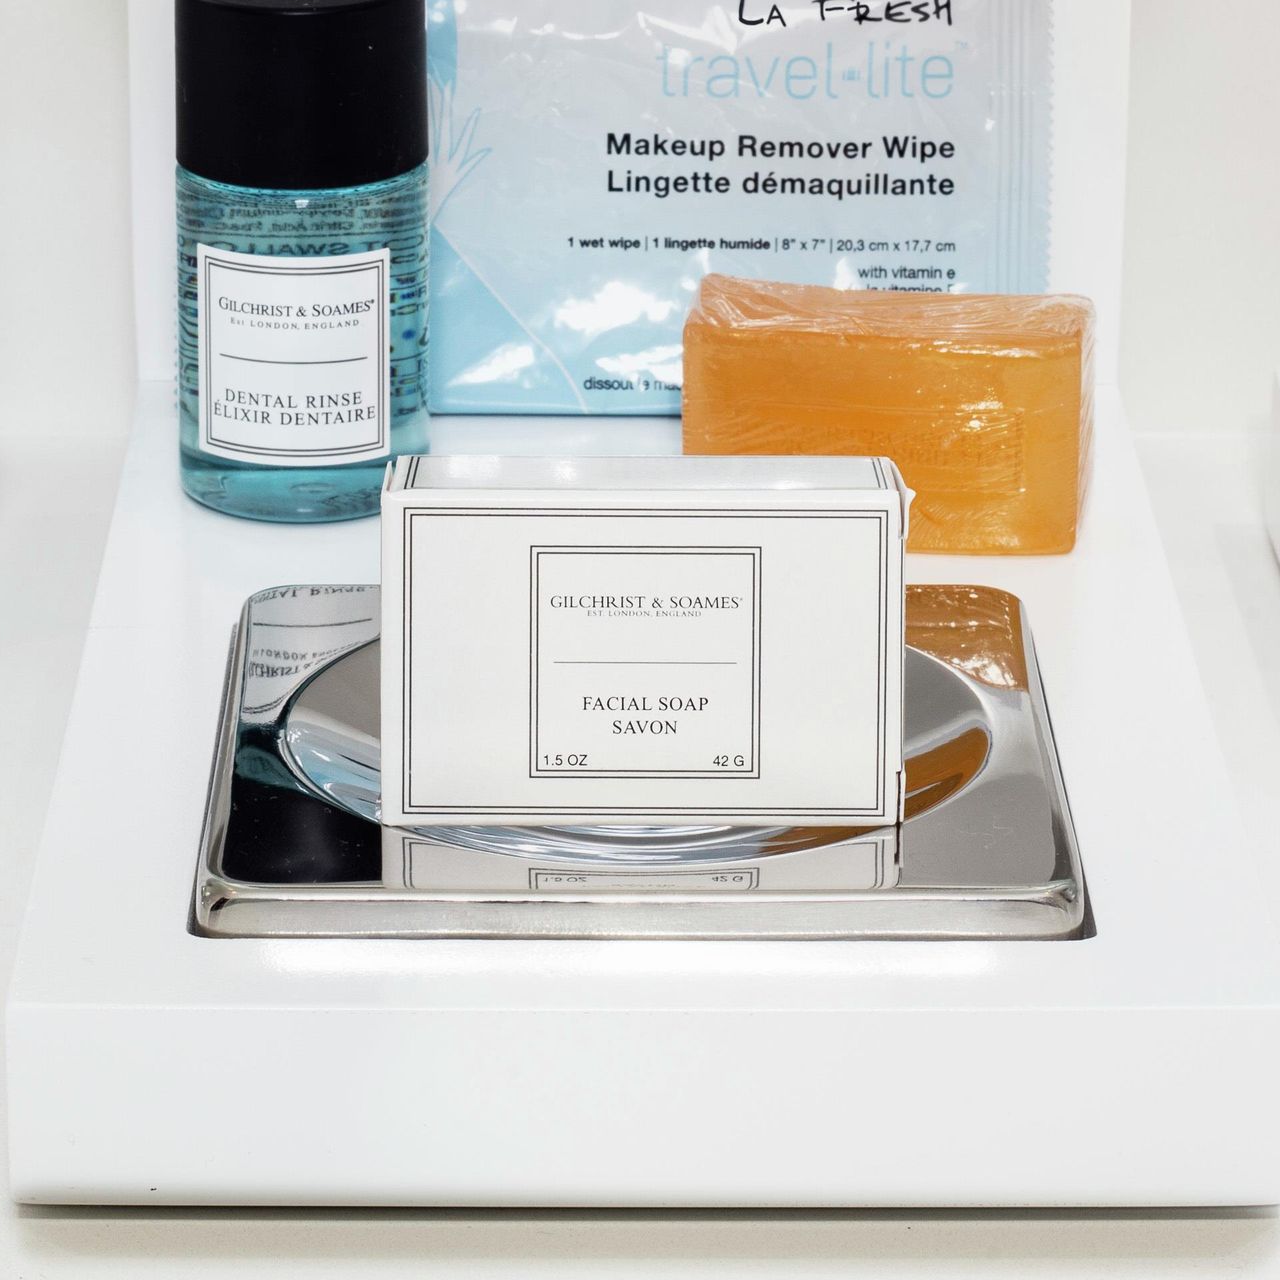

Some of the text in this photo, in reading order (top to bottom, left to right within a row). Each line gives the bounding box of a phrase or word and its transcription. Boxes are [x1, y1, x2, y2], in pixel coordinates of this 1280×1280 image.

[606, 132, 955, 164] Makeup Remover Wipe
[607, 169, 955, 201] Lingette démaquillante
[567, 236, 574, 248] 1
[579, 237, 605, 249] wet
[608, 236, 641, 251] wipe
[652, 237, 659, 249] 1
[664, 237, 716, 252] lingette
[719, 237, 771, 250] humide
[800, 241, 808, 250] x
[836, 238, 866, 253] 20,3
[868, 241, 890, 252] cm
[893, 242, 901, 252] x
[904, 239, 932, 254] 17,7
[935, 242, 956, 253] cm
[857, 265, 956, 280] with vitamin e
[218, 296, 293, 318] GILCHRIST
[295, 305, 307, 318] &
[304, 319, 360, 330] ENGLAND
[223, 388, 362, 413] DENTAL RINSE
[214, 395, 376, 426] ÉLIXIR DENTAIRE
[550, 595, 644, 609] GILCHRIST
[651, 597, 663, 609] &
[583, 696, 709, 711] FACIAL SOAP
[612, 720, 677, 735] SAVON
[543, 753, 588, 767] 1.5 OZ
[712, 754, 745, 767] 42 G
